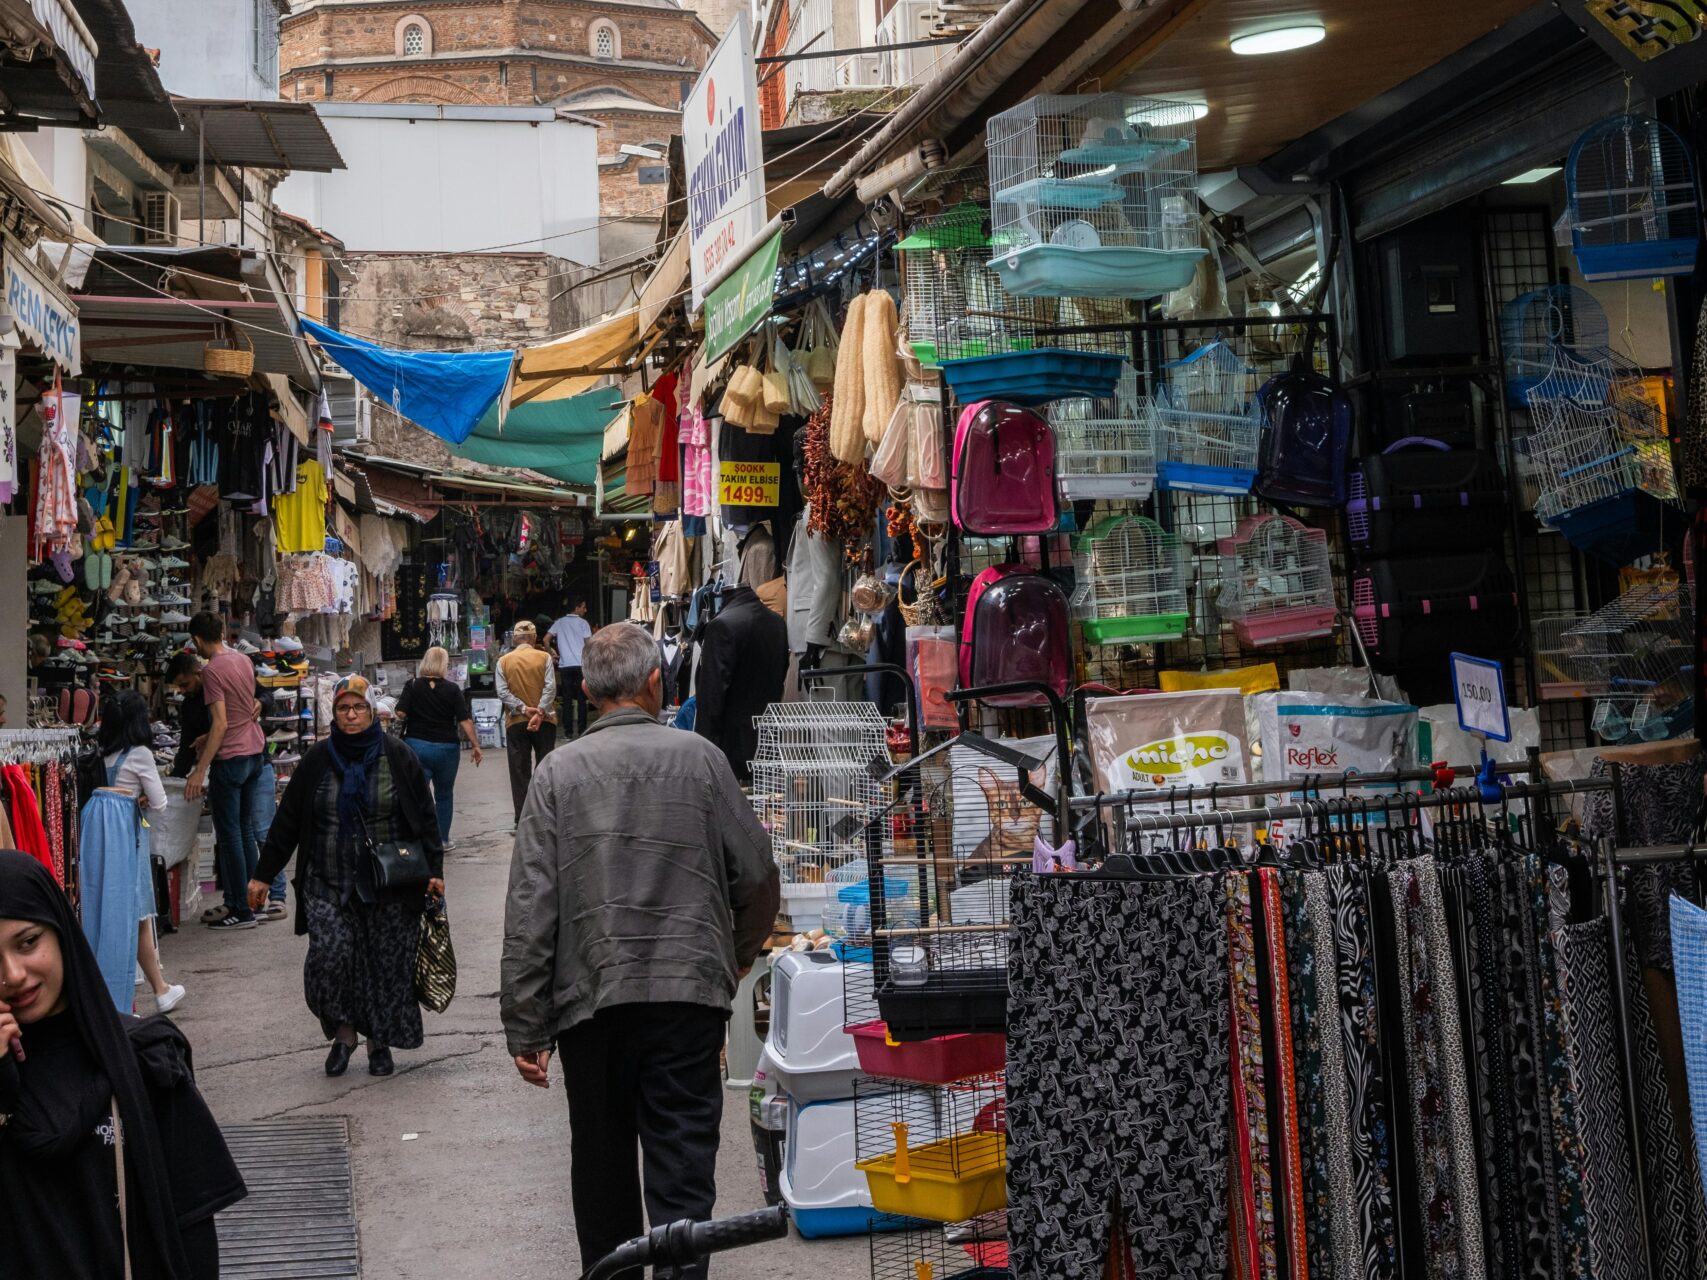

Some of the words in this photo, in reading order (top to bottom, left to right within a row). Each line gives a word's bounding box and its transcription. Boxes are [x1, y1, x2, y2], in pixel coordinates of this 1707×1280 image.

[7, 265, 41, 334] REM
[734, 464, 765, 474] ŞOOKK
[720, 474, 747, 483] TAKIM
[749, 475, 779, 485] ELBİSE
[1462, 682, 1491, 703] 150.00
[1288, 747, 1338, 770] Reflex
[1132, 771, 1149, 783] ADULT
